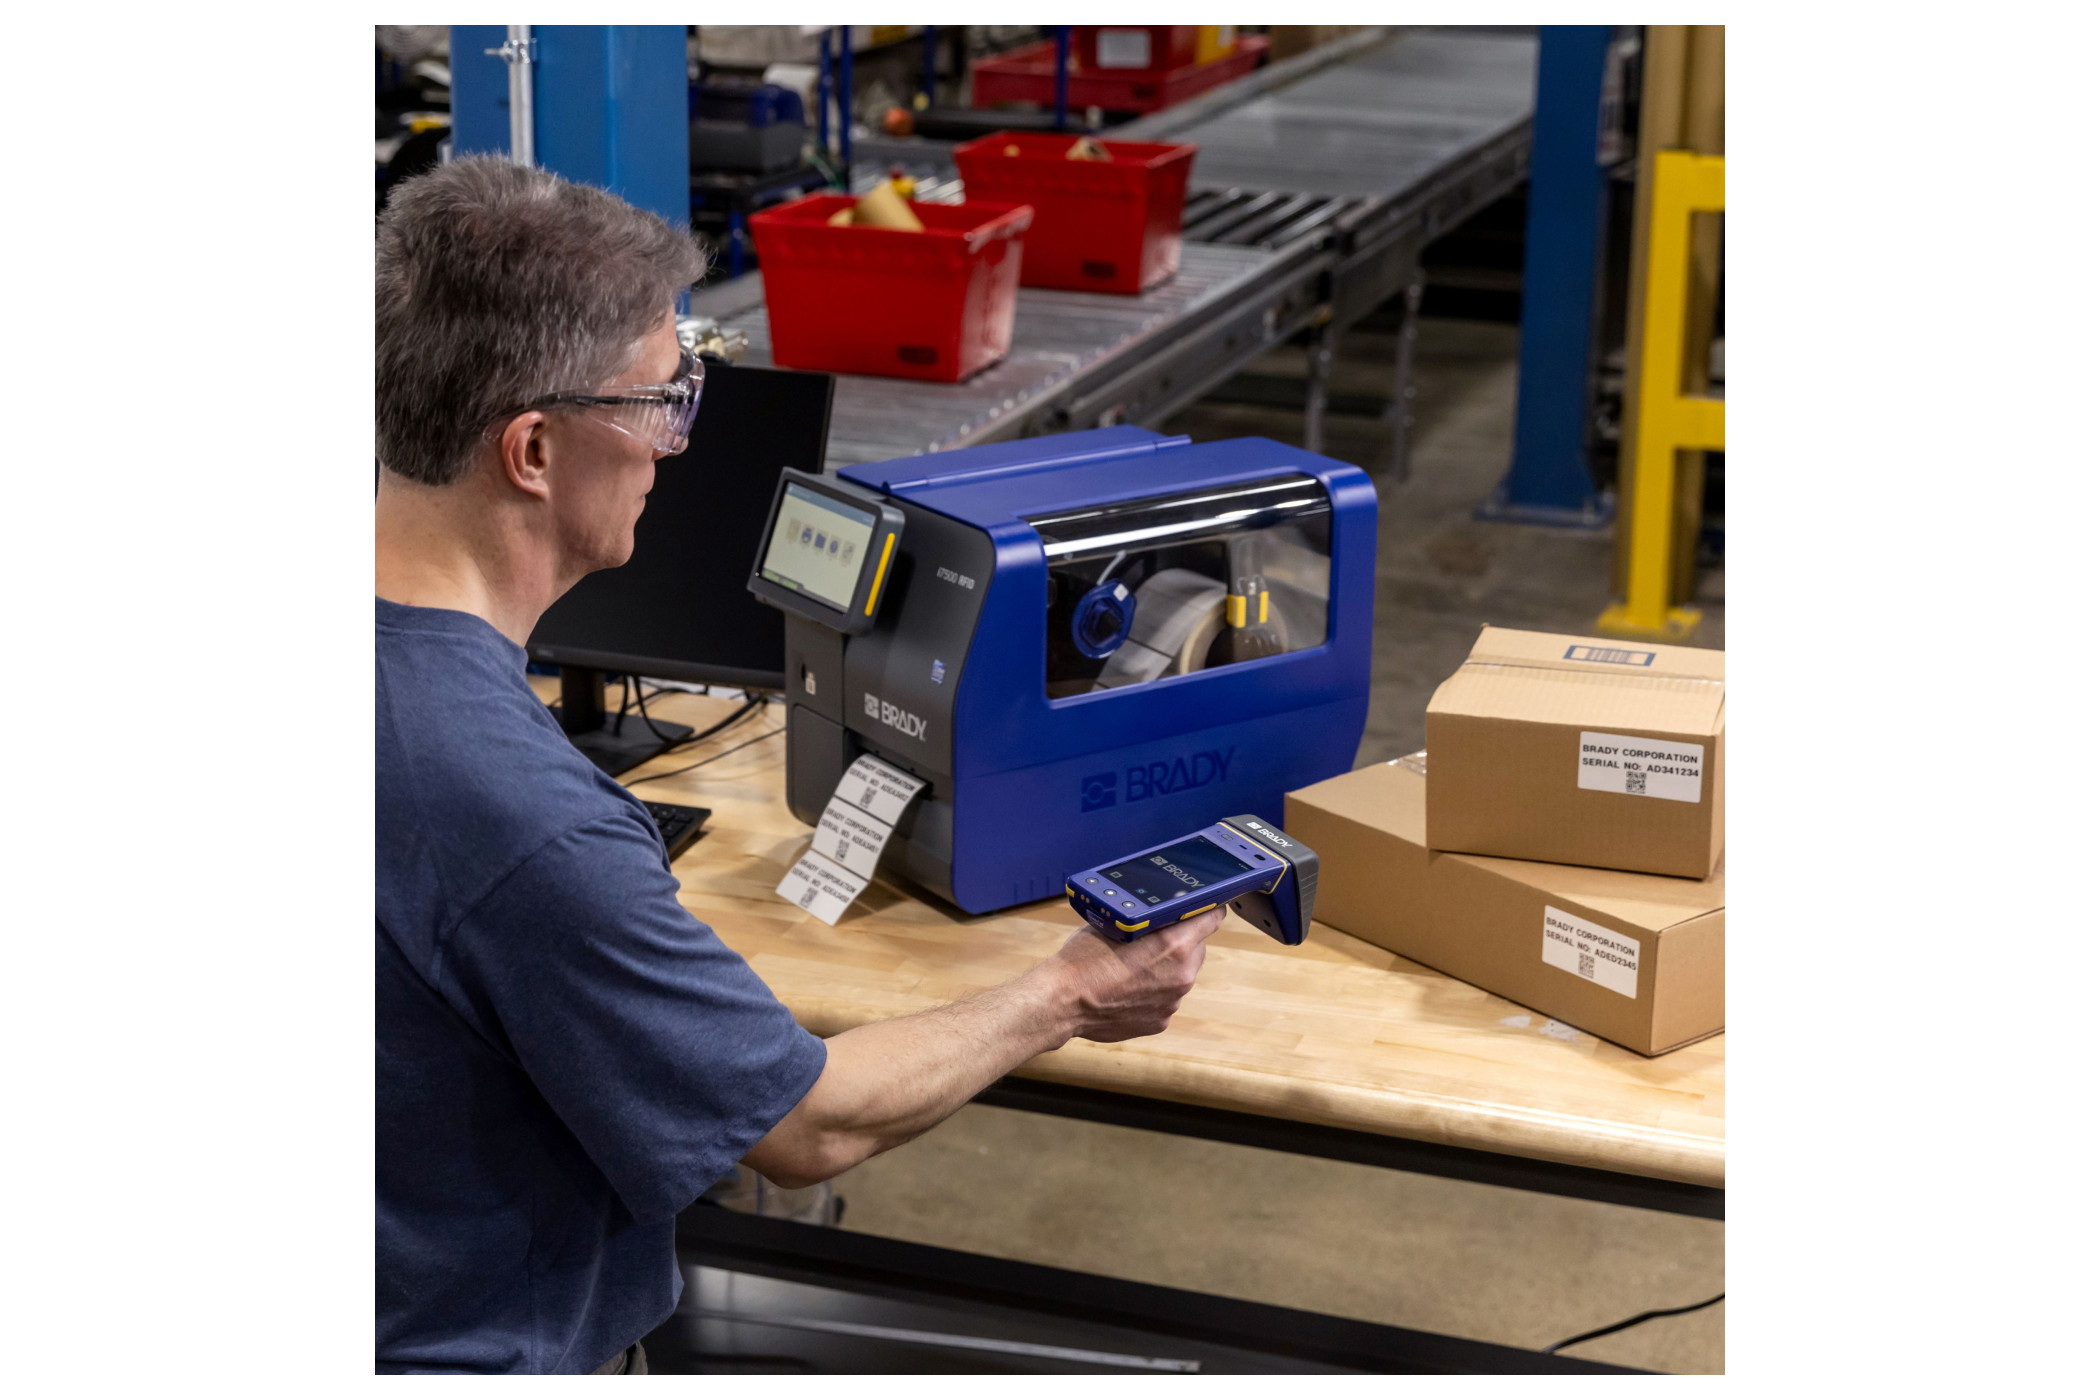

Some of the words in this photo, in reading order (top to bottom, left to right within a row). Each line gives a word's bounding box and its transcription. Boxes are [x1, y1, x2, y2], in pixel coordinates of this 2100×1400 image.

[881, 700, 927, 741] BRADY
[1582, 744, 1619, 756] BRADY
[1622, 748, 1698, 764] CORPORATION
[1582, 757, 1620, 769] SERIAL
[1624, 762, 1642, 772] NO:
[1646, 764, 1699, 777] AD341234
[847, 767, 868, 781] SERIAL
[856, 759, 877, 771] BRADY
[875, 768, 916, 791] CORPORATION
[1126, 746, 1235, 803] BRADY
[820, 818, 839, 834] SERIAL
[825, 807, 846, 820] BRADY
[844, 818, 884, 842] CORPORATION
[1257, 828, 1294, 848] BRADY
[791, 867, 811, 882] SERIAL
[799, 859, 820, 872] BRADY
[818, 869, 857, 894] CORPORATION
[1162, 864, 1206, 888] BRADY
[1545, 930, 1575, 948] SERIAL
[1577, 942, 1592, 954] NO:
[1594, 949, 1637, 971] ADED2345
[1546, 917, 1574, 934] BRADY
[1576, 928, 1636, 957] CORPORATION
